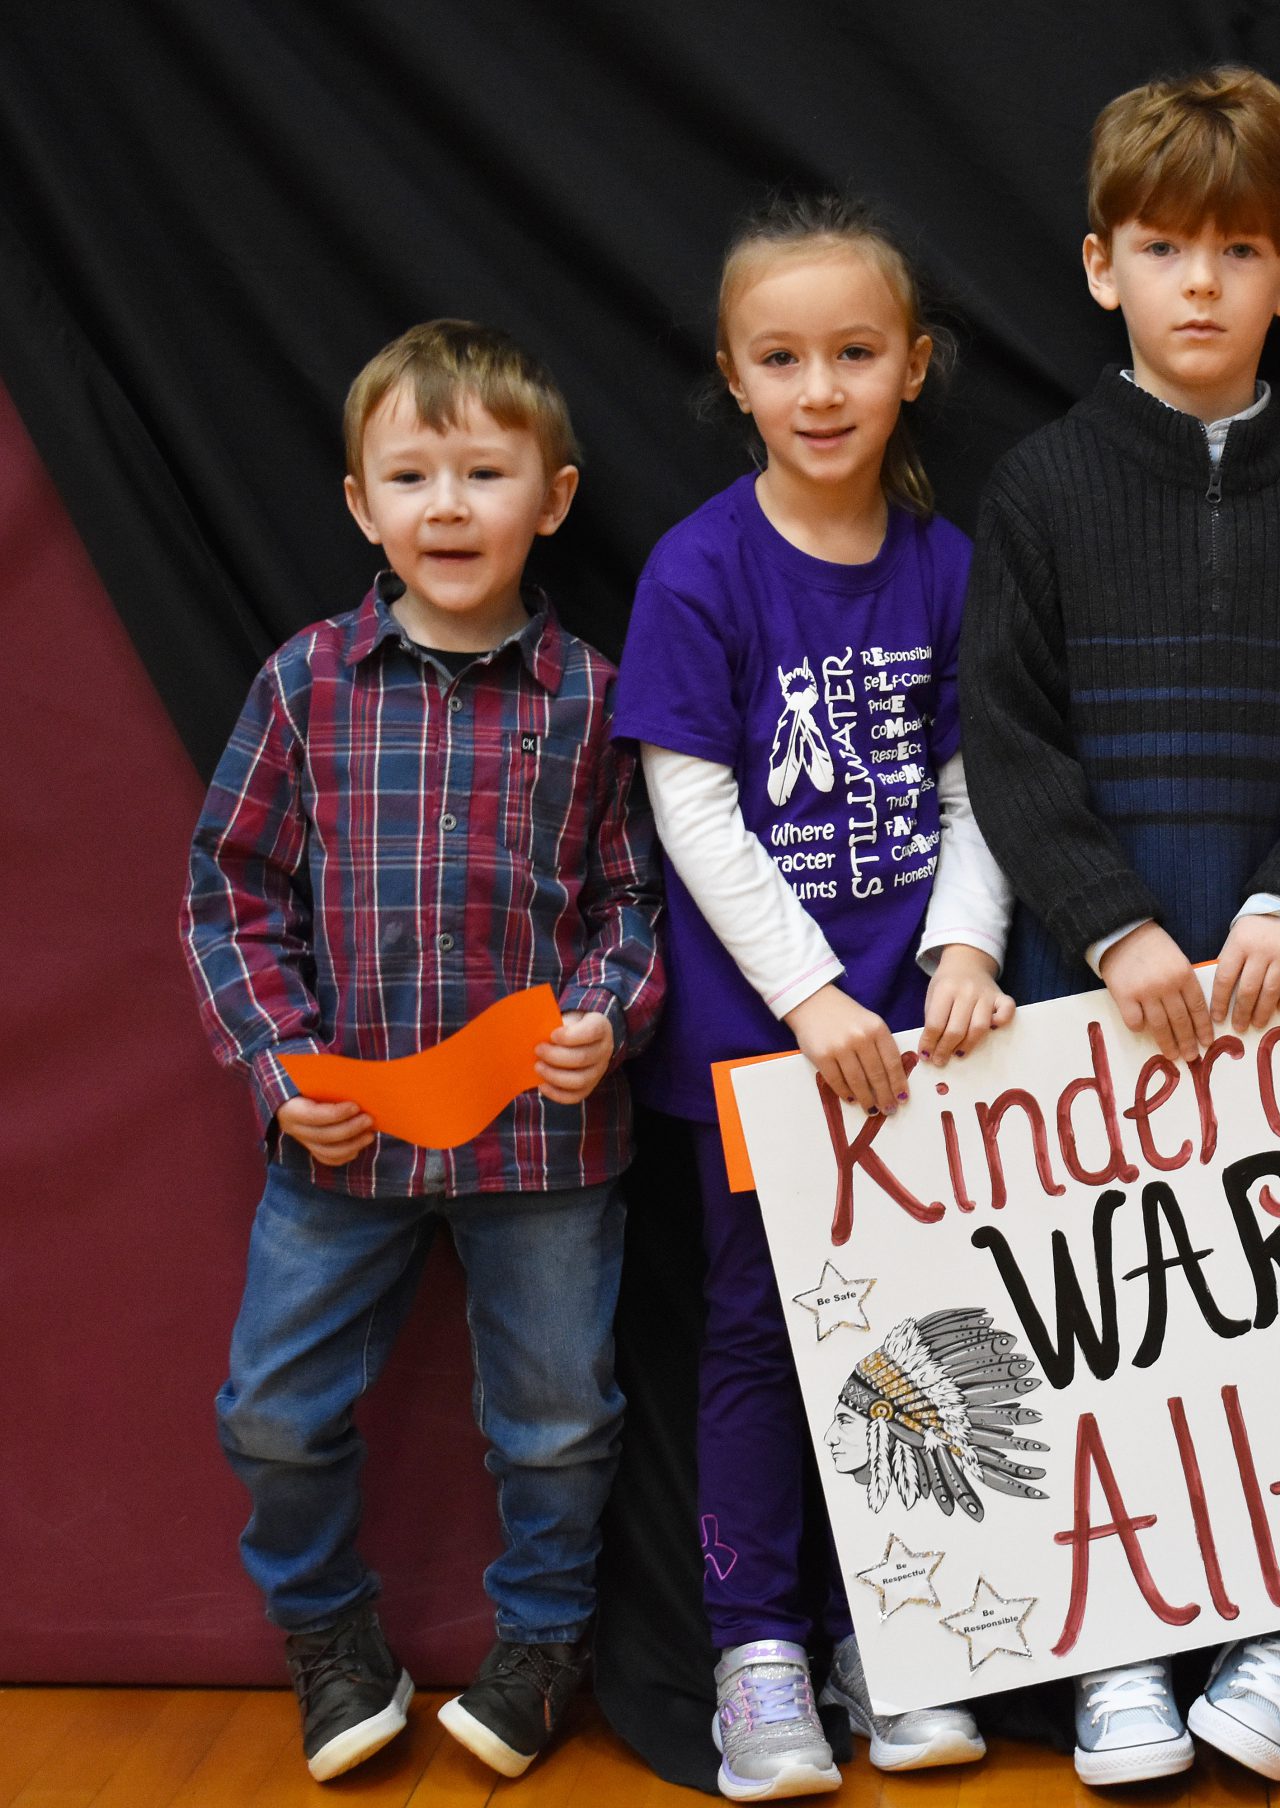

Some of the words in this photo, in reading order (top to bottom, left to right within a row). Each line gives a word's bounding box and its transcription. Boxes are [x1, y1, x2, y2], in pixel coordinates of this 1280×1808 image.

[822, 646, 883, 899] STILLWATER
[771, 822, 835, 847] Where
[773, 852, 836, 873] racter
[792, 880, 838, 900] unts
[817, 1297, 831, 1306] Be
[833, 1291, 857, 1302] Safe
[882, 1568, 926, 1585] Respectful
[982, 1609, 995, 1617] Be
[963, 1615, 1019, 1633] Responsible
